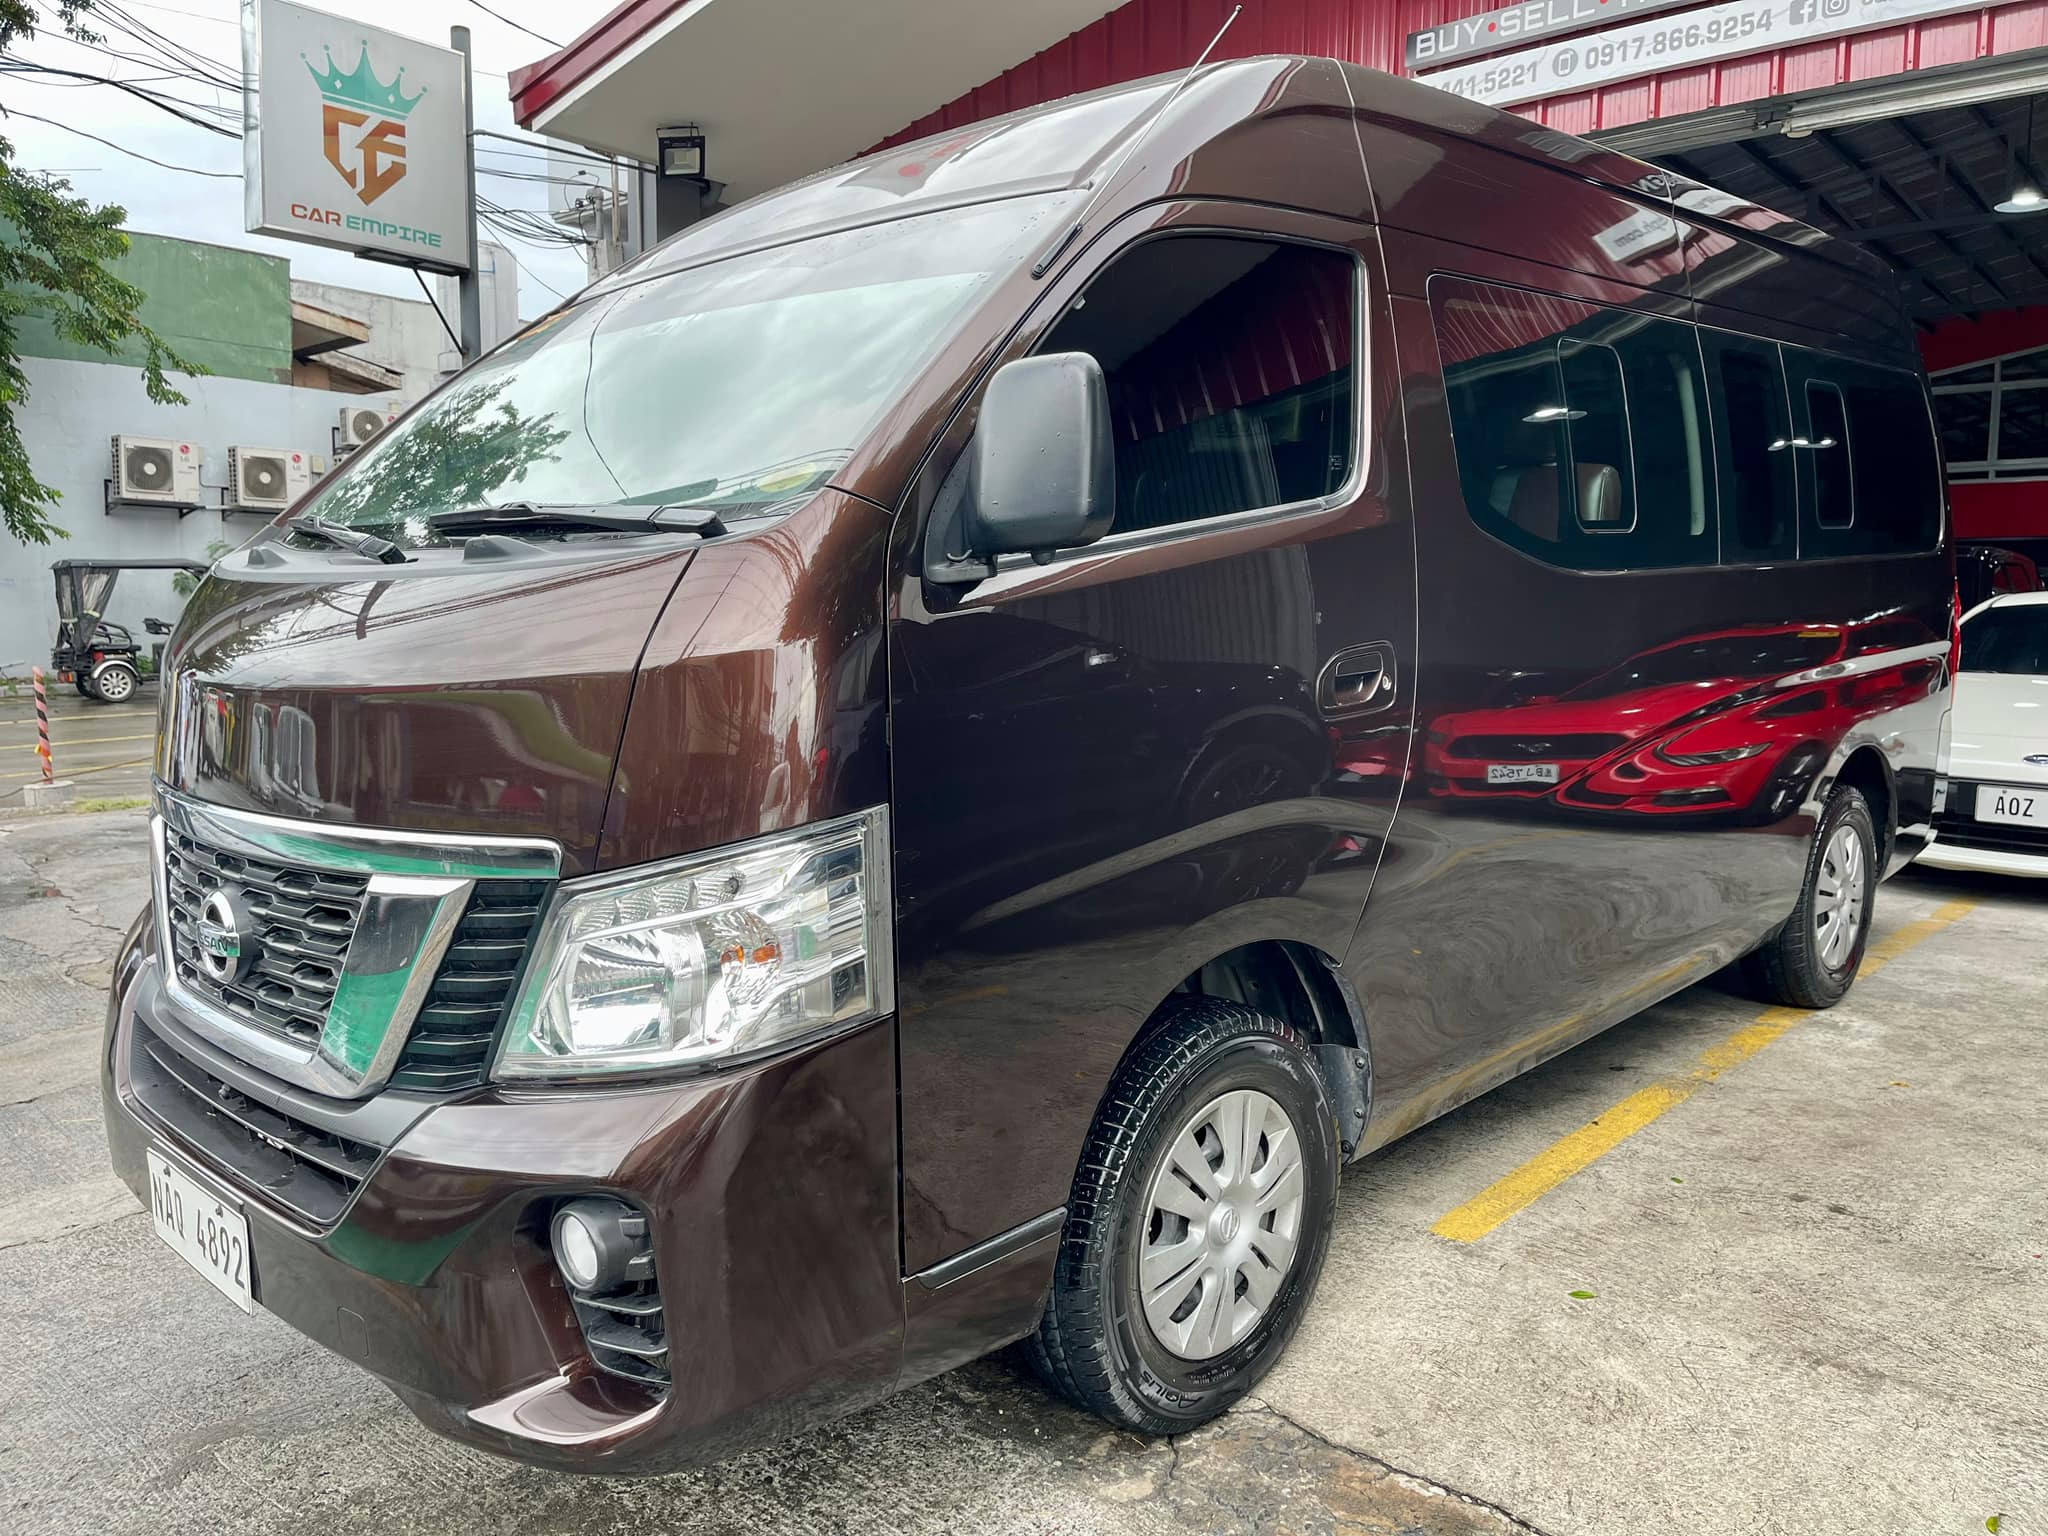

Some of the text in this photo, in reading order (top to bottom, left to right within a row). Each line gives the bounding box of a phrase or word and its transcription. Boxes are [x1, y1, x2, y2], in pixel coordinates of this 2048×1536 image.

[1415, 0, 1595, 59] BUY SELL
[1436, 8, 1773, 97] 441.5221 0917.866.9254
[291, 203, 442, 248] CAR EMPIRE
[1994, 796, 2035, 818] AOZ
[152, 1171, 246, 1290] NAQ 4892
